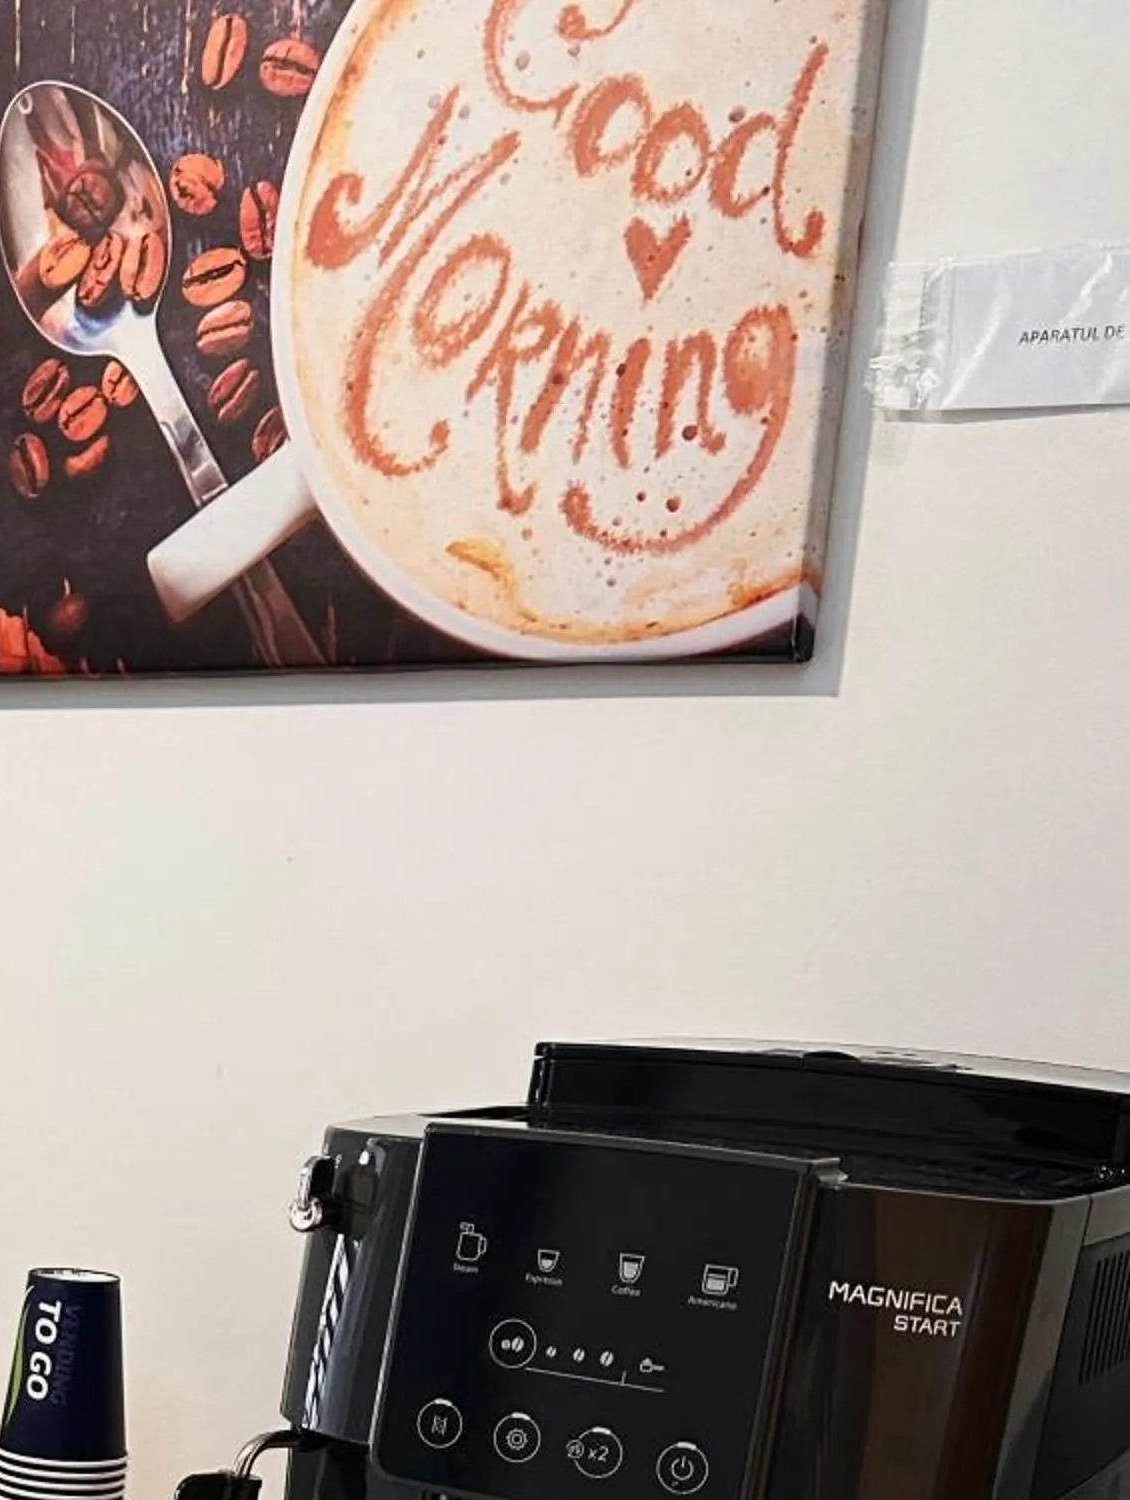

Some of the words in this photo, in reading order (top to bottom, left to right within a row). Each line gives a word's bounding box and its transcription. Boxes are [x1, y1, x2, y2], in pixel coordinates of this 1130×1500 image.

[1018, 327, 1099, 345] APARATUL
[1104, 325, 1125, 340] DE
[610, 1284, 641, 1297] Coffee
[828, 1280, 963, 1316] MAGNIFICA
[37, 1300, 62, 1344] TO
[893, 1314, 961, 1337] START
[27, 1351, 52, 1400] GO
